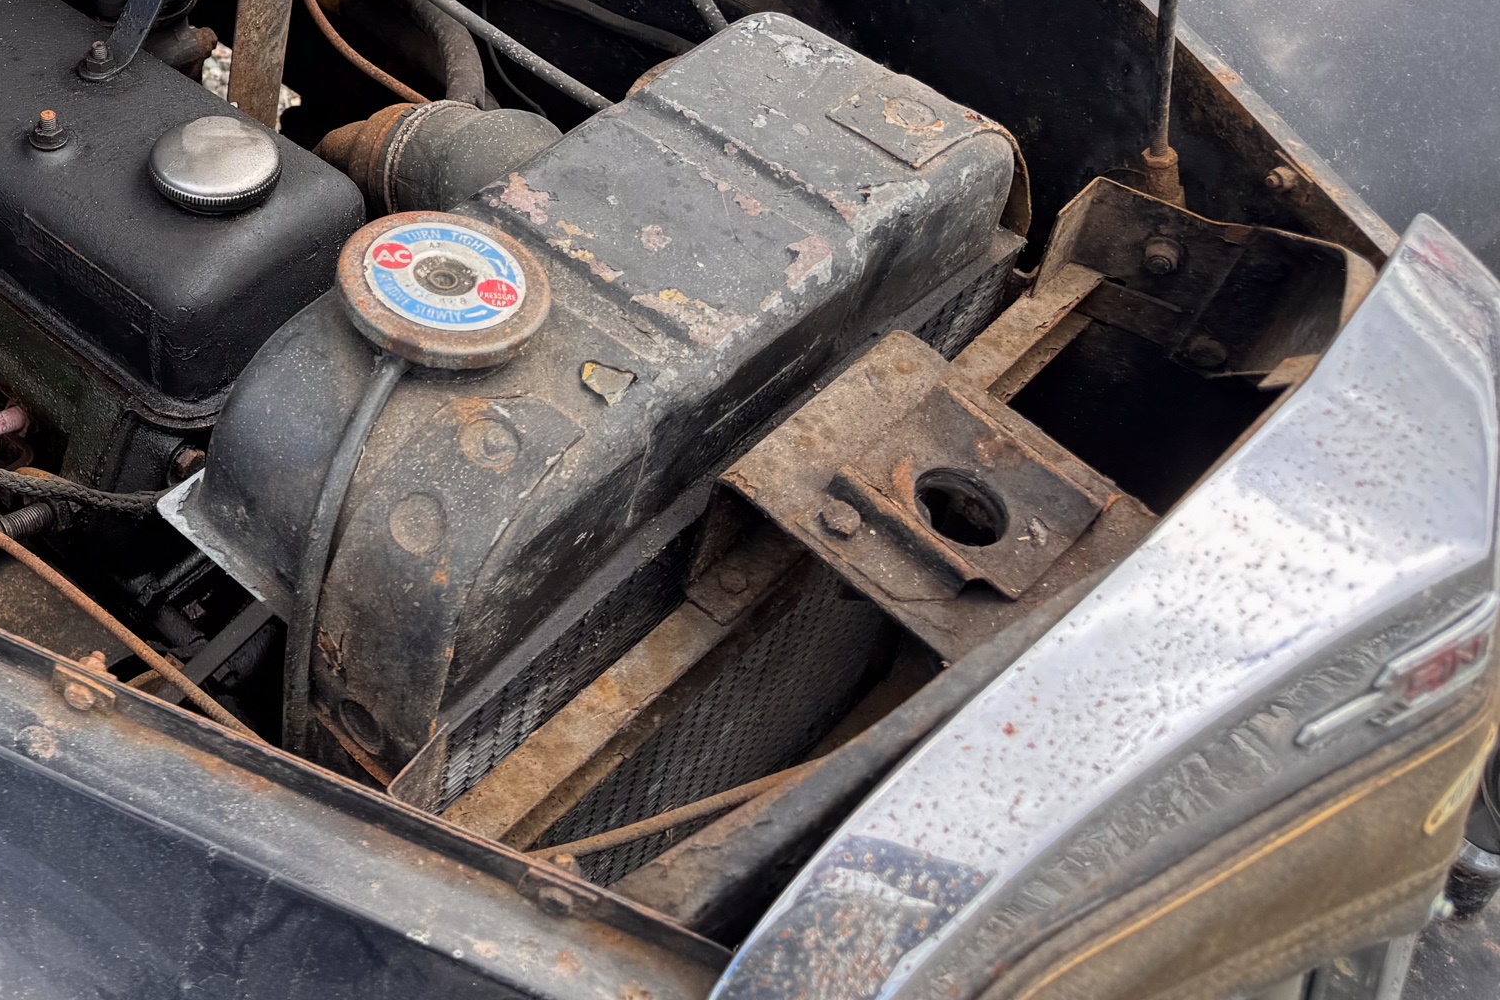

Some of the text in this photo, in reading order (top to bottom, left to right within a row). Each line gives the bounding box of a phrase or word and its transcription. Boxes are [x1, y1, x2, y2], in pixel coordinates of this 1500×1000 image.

[404, 229, 492, 254] TURN TIGHT
[375, 249, 411, 264] AC
[479, 291, 516, 302] PRESSURE
[491, 299, 508, 307] CAP
[413, 304, 462, 323] SLOWLY
